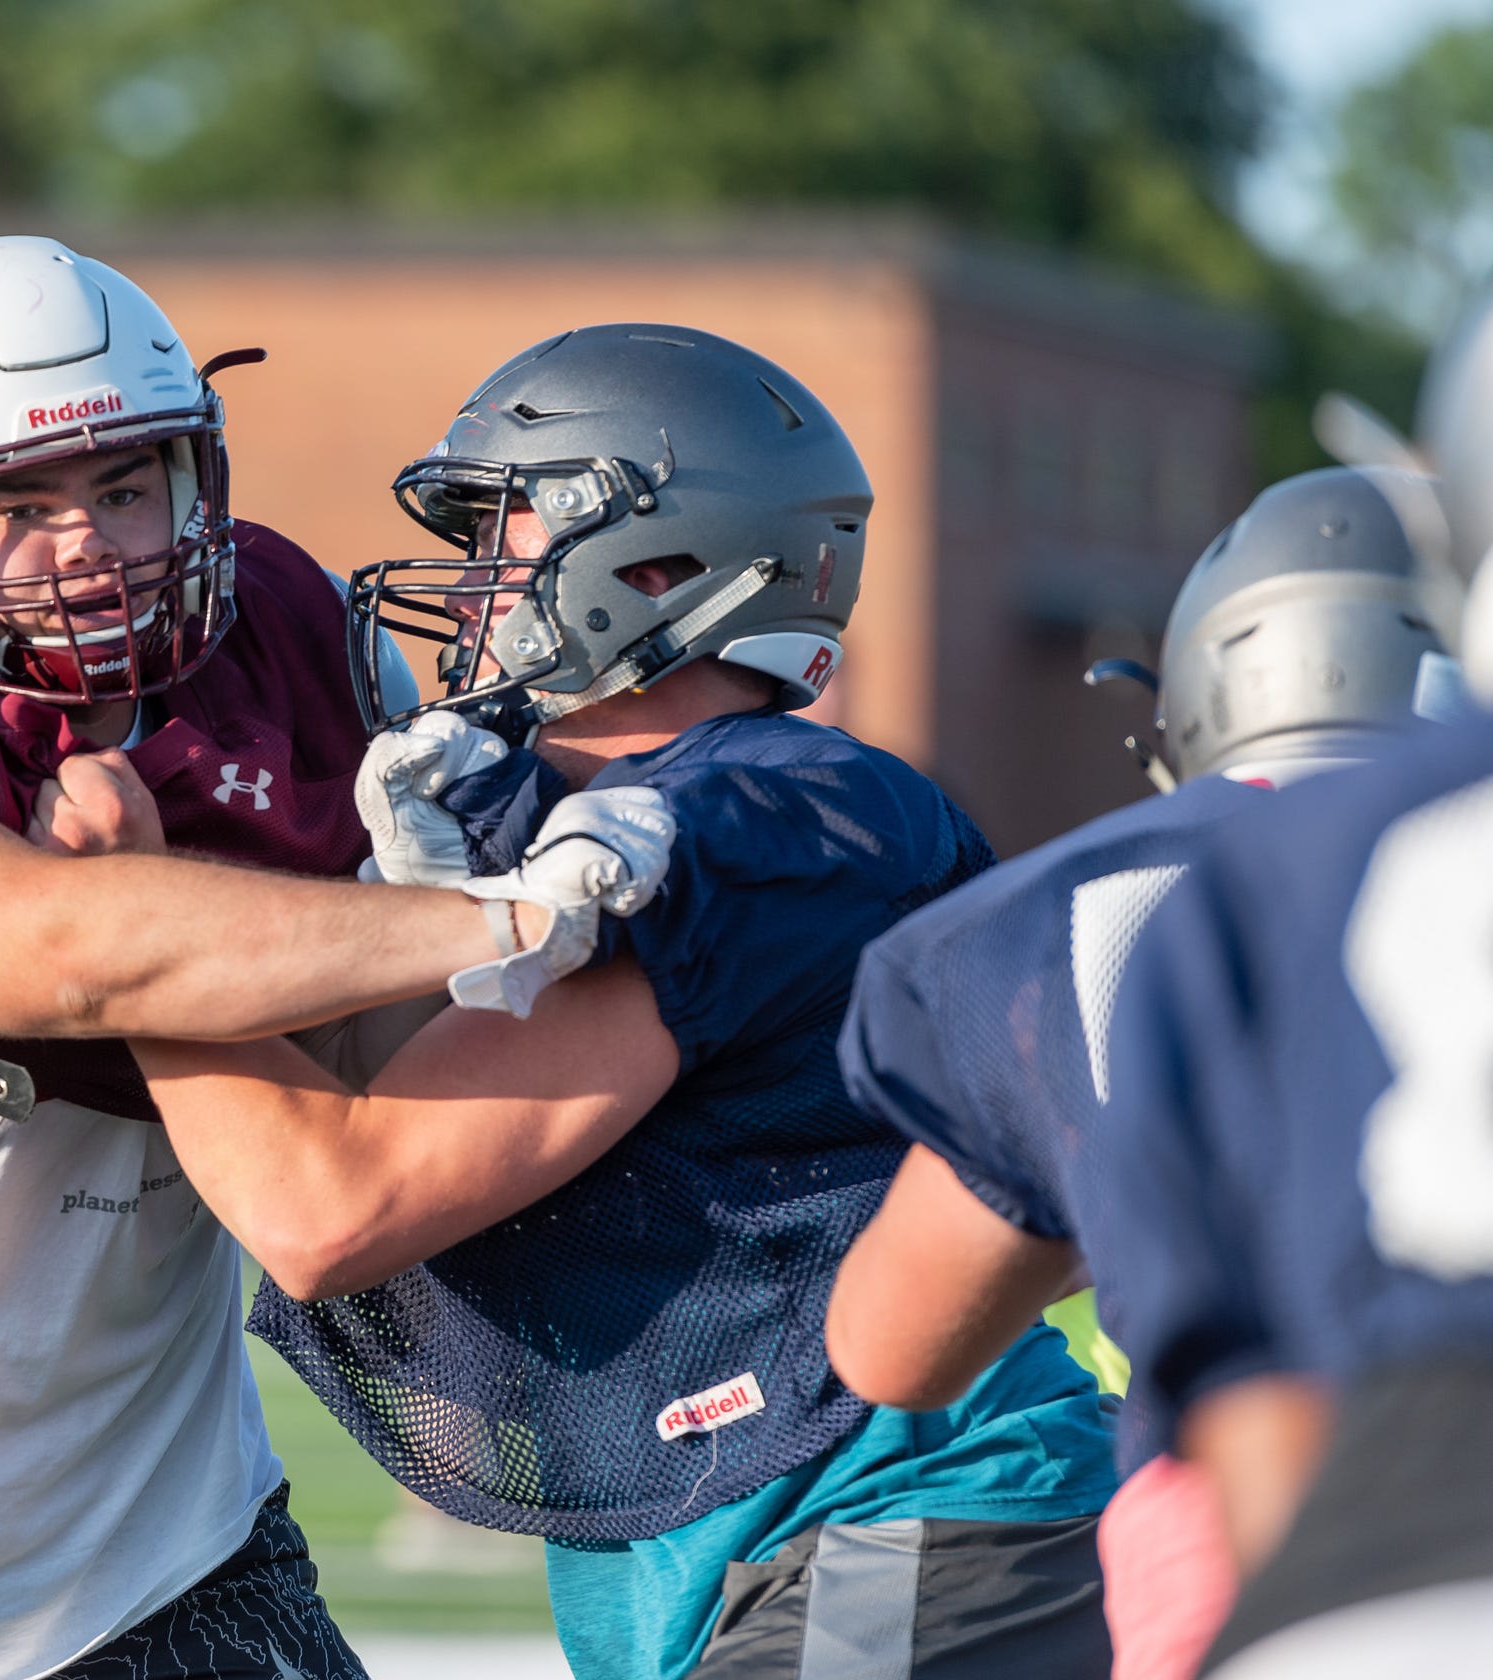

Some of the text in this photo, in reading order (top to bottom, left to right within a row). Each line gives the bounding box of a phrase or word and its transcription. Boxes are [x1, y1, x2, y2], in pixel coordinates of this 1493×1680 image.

[28, 393, 123, 429] Riddell
[60, 1168, 183, 1214] planet ness
[665, 1386, 750, 1431] Riddell
